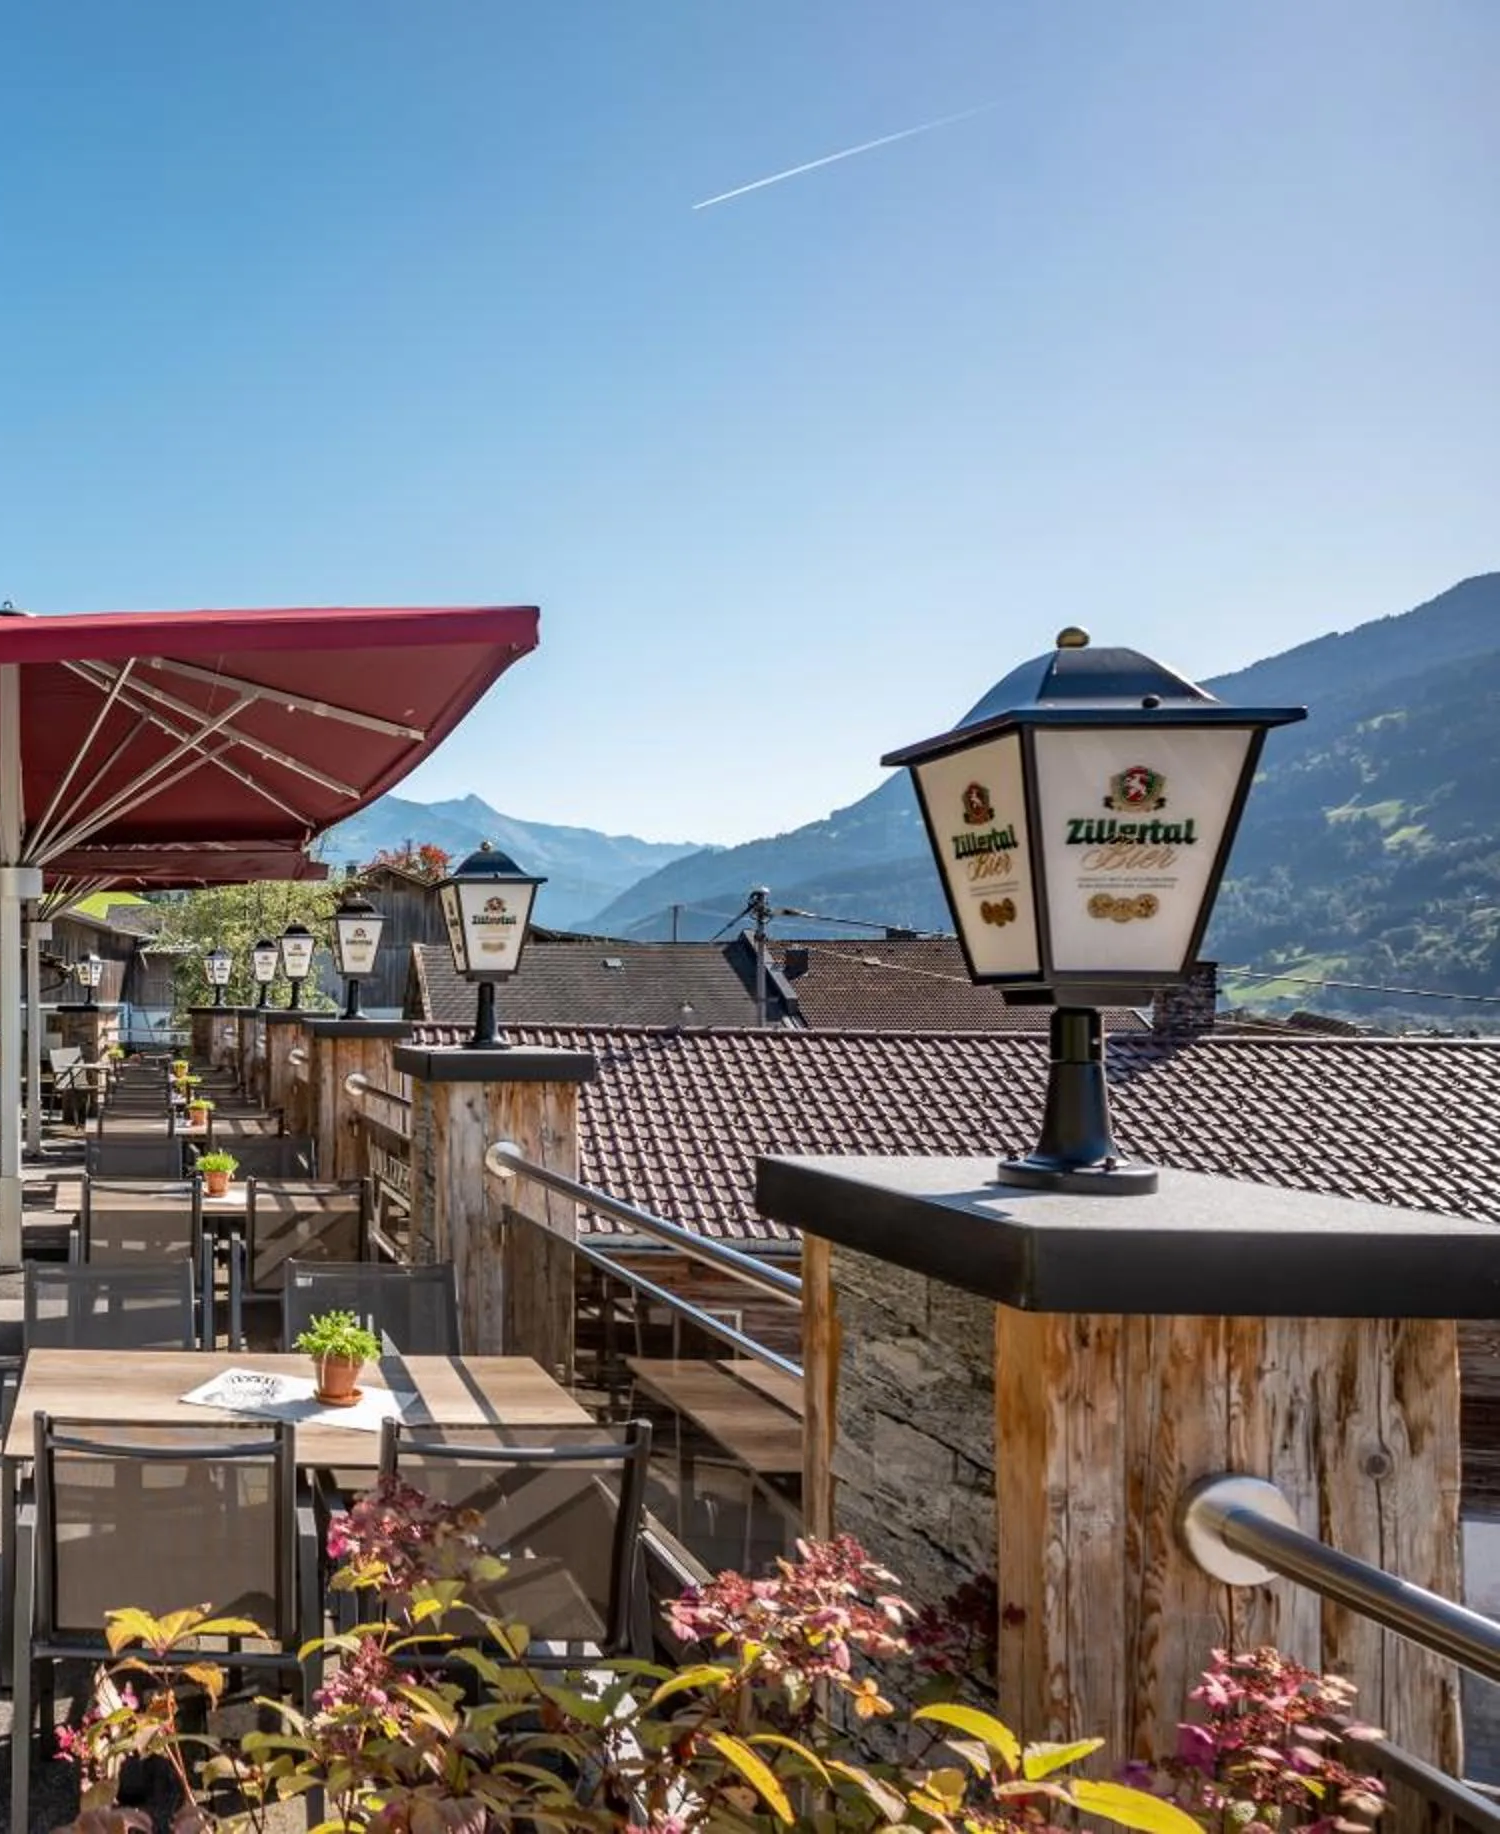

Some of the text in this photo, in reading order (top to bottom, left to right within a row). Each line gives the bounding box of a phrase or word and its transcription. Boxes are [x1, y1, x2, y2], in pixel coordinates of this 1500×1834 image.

[952, 824, 1018, 859] Zillertal
[1066, 818, 1198, 845] Zillertal
[1080, 839, 1178, 871] Bier
